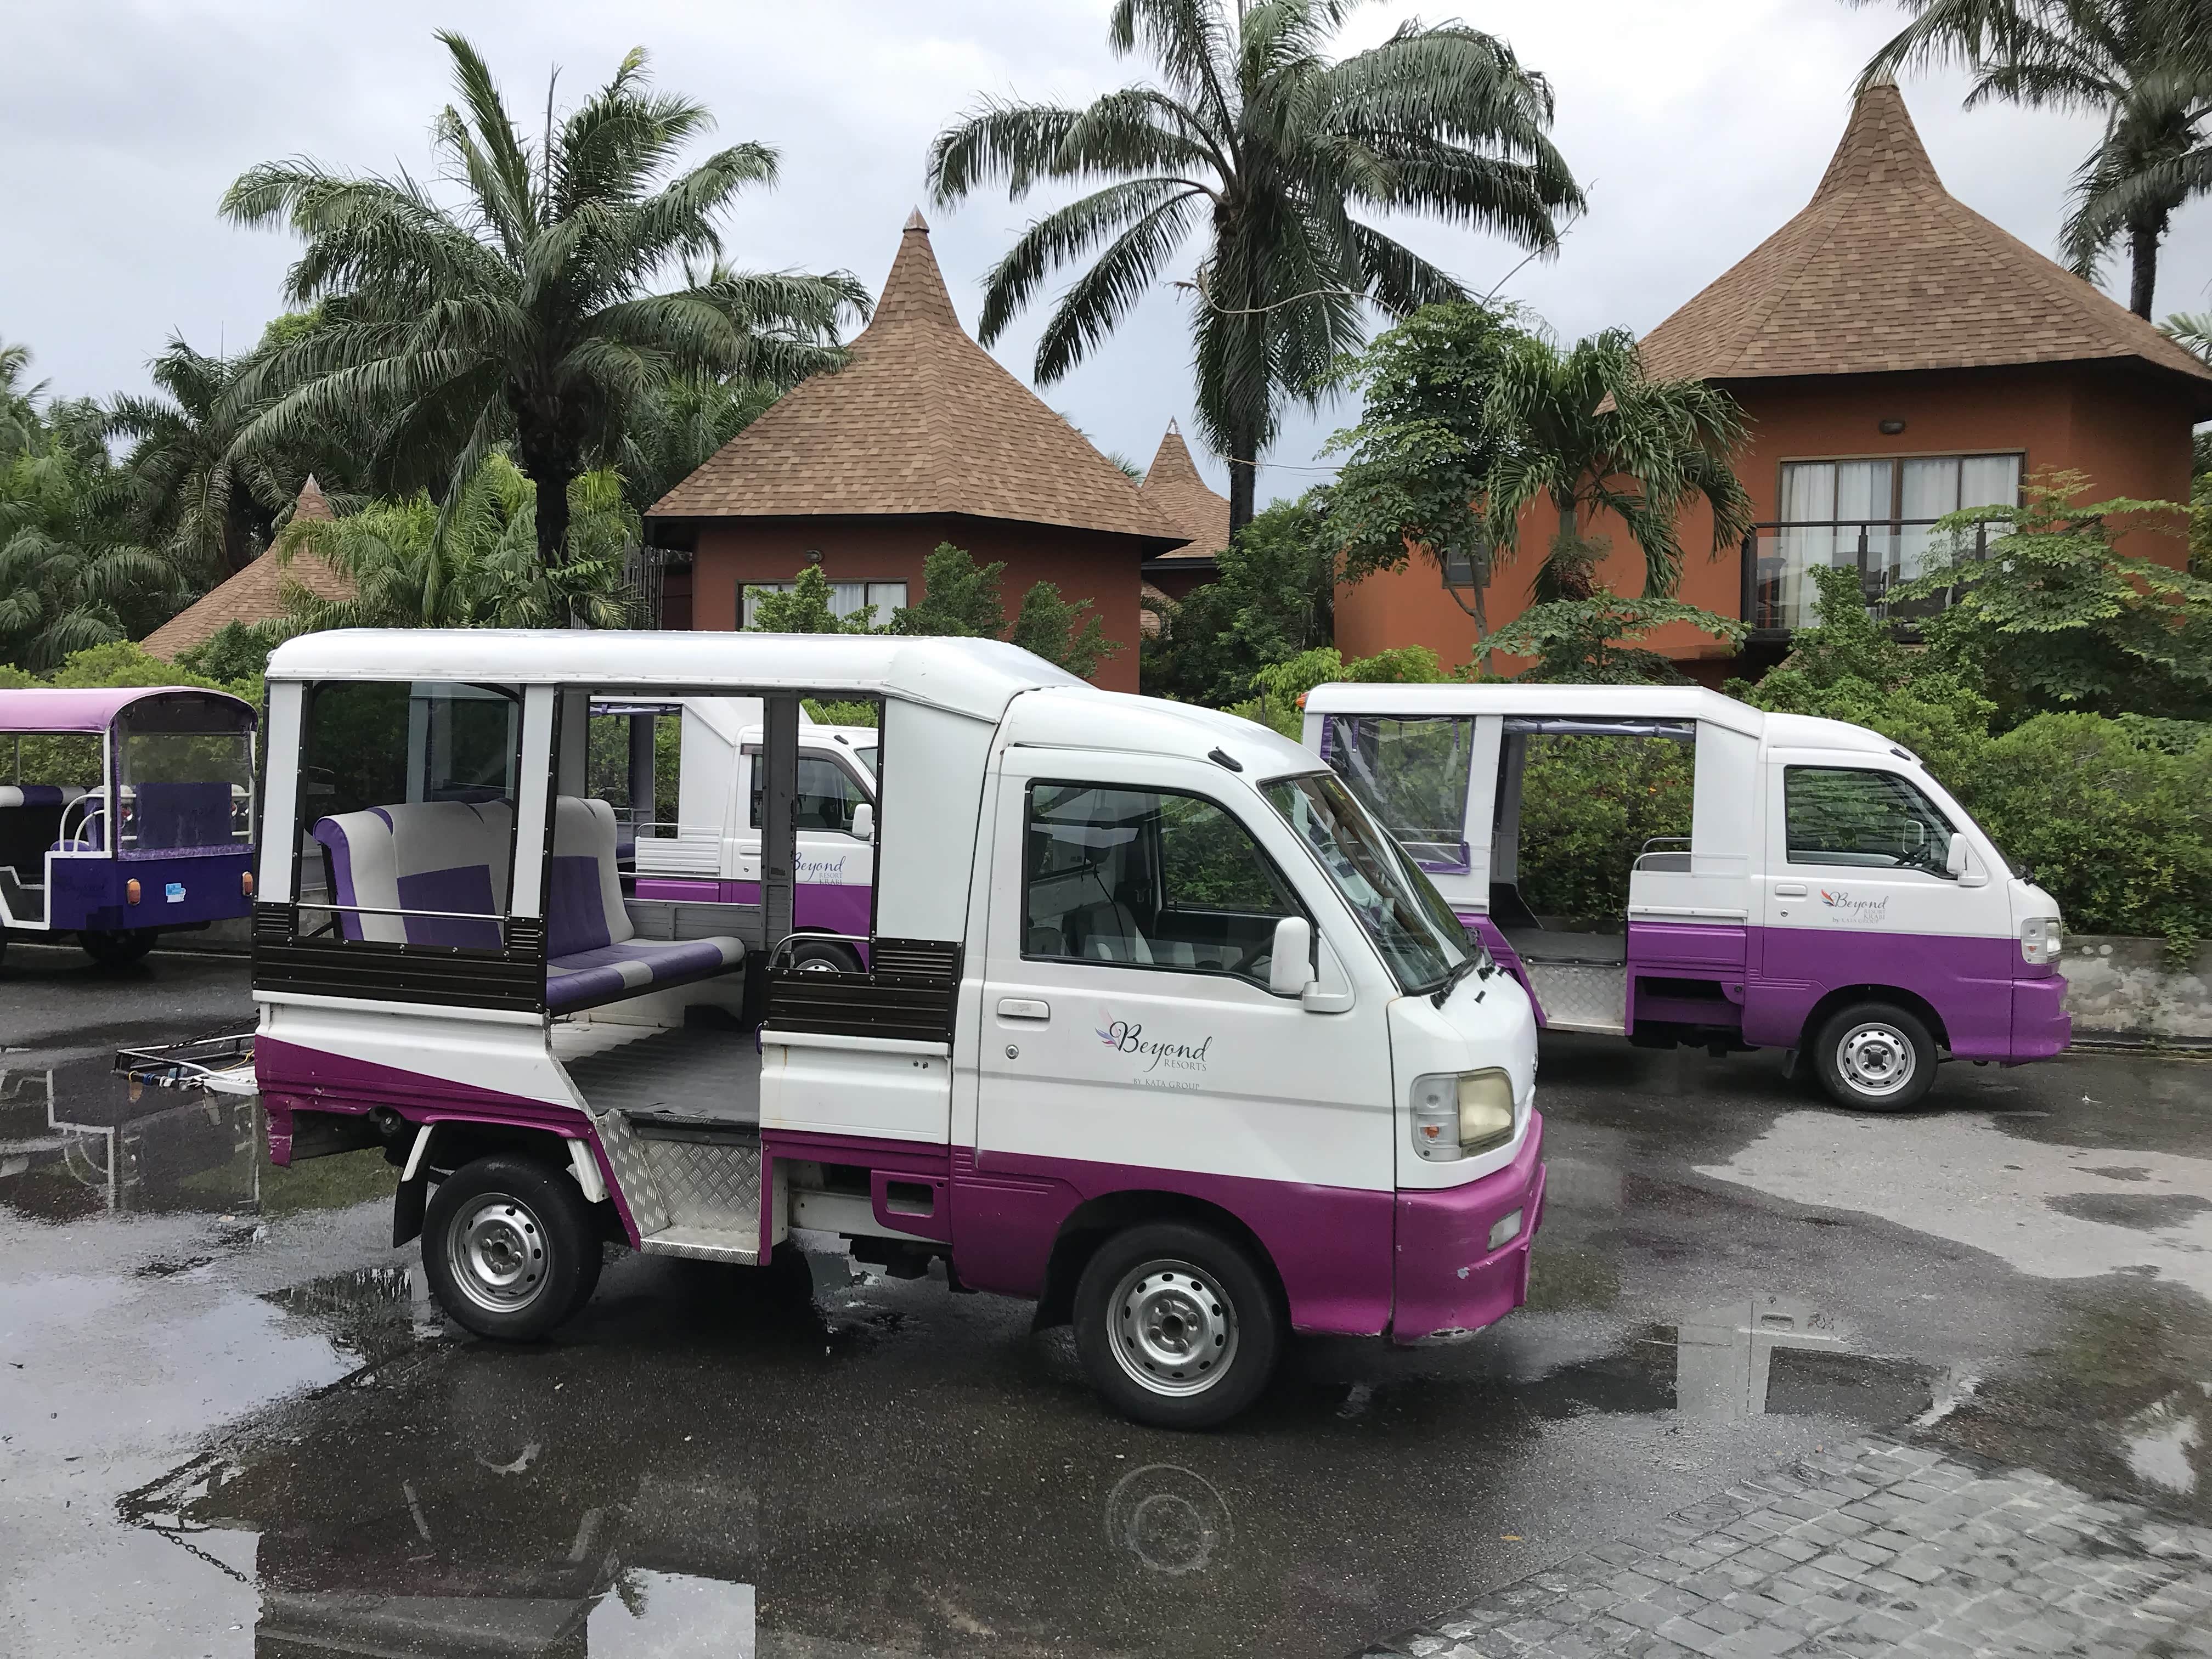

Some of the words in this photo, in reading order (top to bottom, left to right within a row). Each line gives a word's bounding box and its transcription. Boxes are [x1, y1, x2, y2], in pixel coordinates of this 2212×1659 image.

[1830, 891, 1889, 917] Beyond
[1109, 1021, 1212, 1073] Beyond
[1164, 1059, 1207, 1071] RESORTS
[1146, 1079, 1166, 1087] KATA
[1169, 1081, 1200, 1091] GROUP
